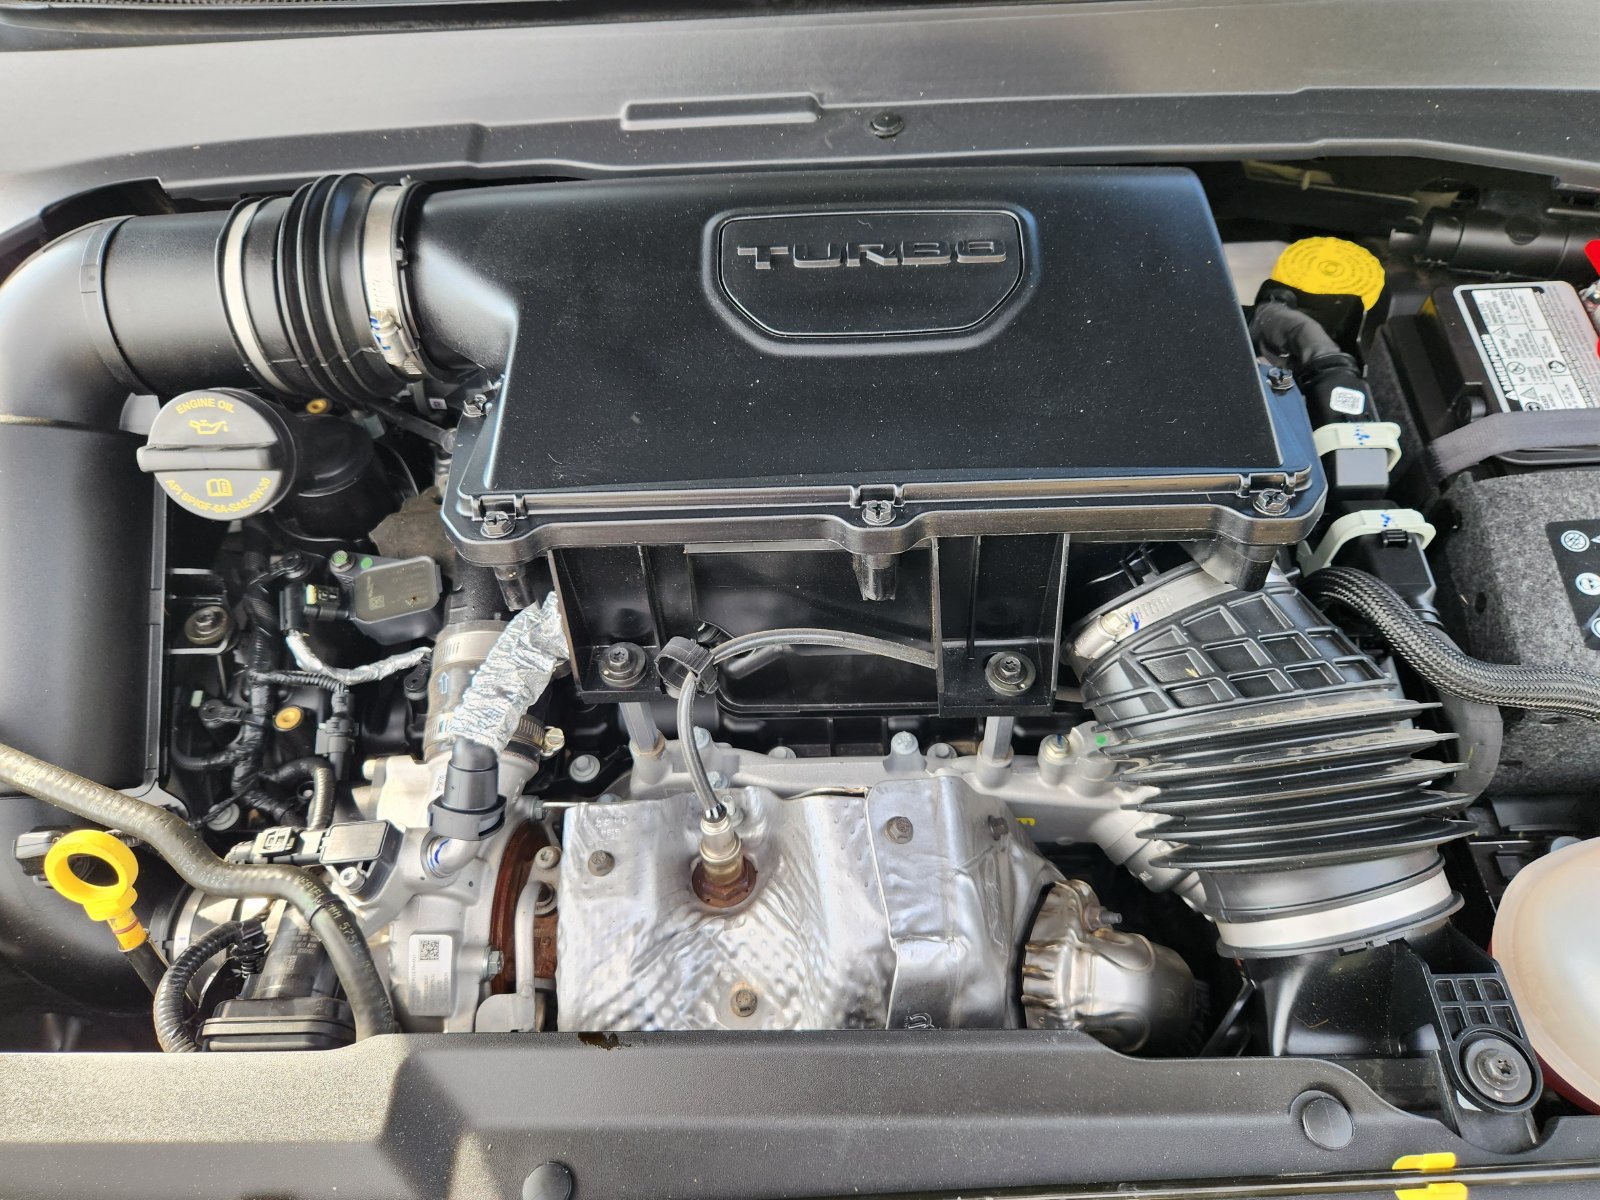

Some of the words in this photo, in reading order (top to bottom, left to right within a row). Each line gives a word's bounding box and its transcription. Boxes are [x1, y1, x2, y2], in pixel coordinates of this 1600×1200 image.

[737, 240, 1007, 270] TURBO
[176, 398, 215, 414] ENGINE
[217, 400, 235, 413] OIL
[166, 479, 183, 496] API
